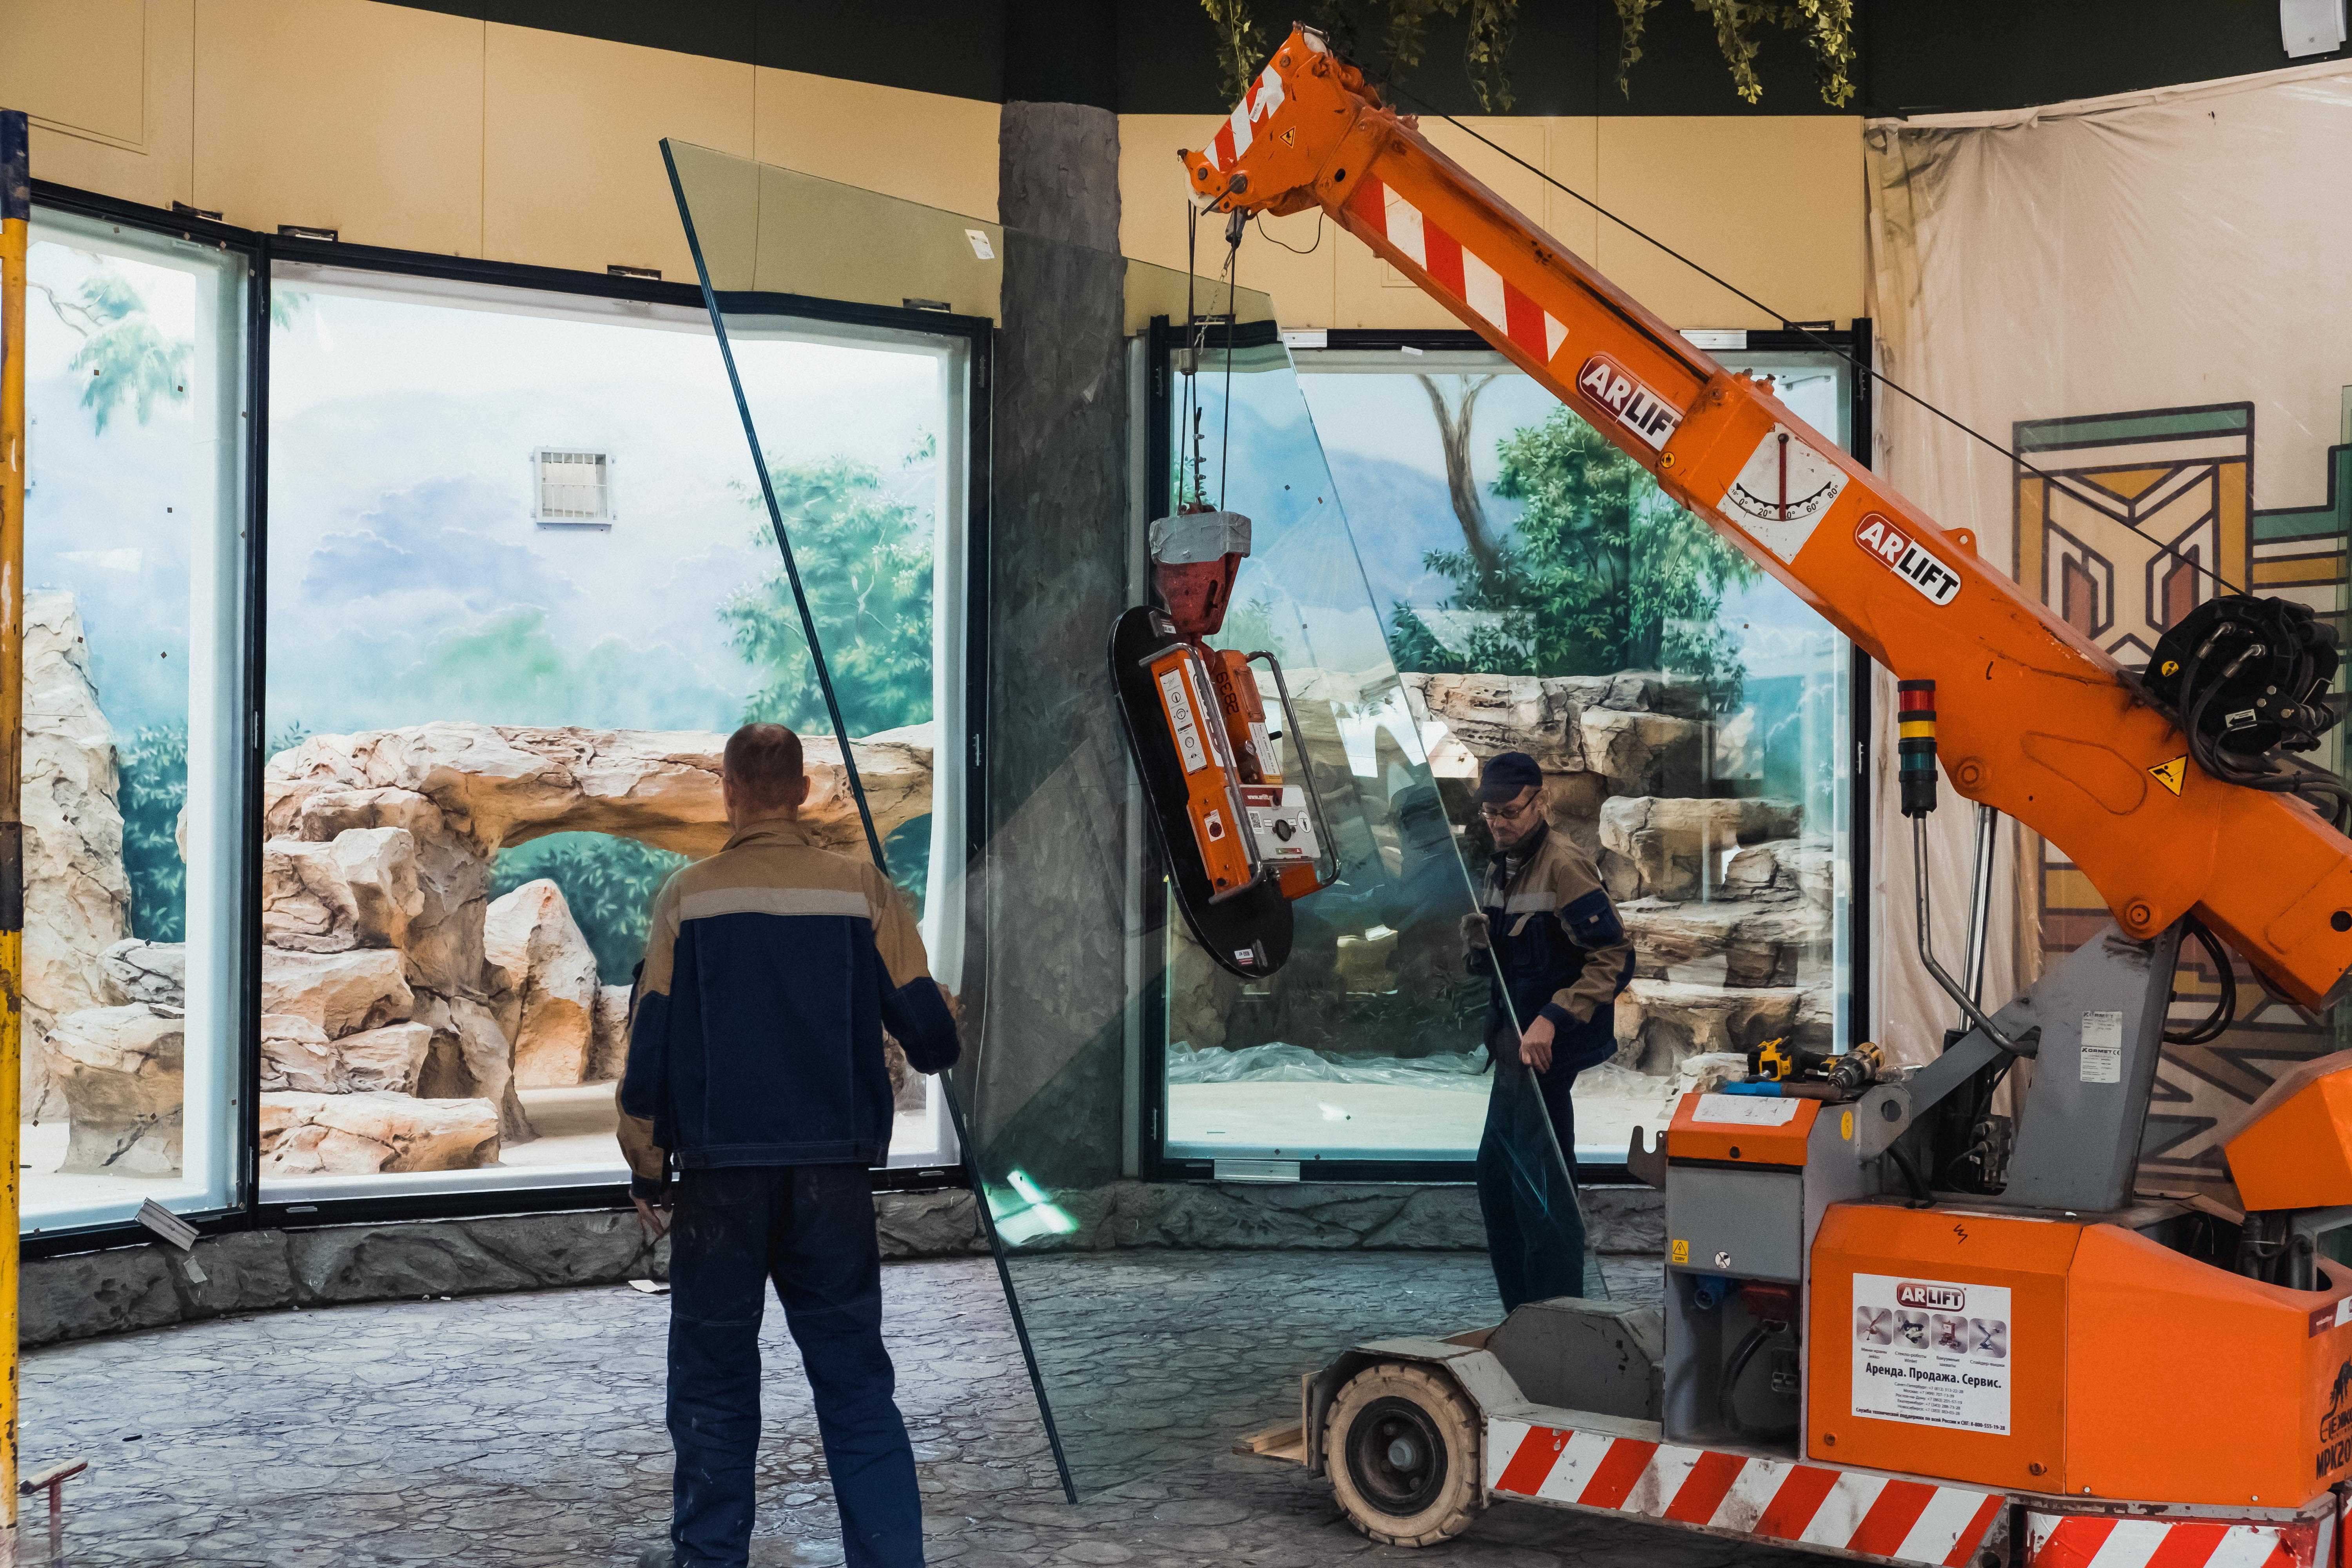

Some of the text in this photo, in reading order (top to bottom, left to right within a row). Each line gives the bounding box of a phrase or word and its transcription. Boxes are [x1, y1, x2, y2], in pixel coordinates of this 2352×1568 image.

[1785, 511, 1795, 519] 0°
[1858, 521, 1959, 599] ARLIFT
[1901, 1287, 1961, 1307] ARLIFT
[1866, 1363, 2001, 1388] Аренда. Продажа. Сервис.
